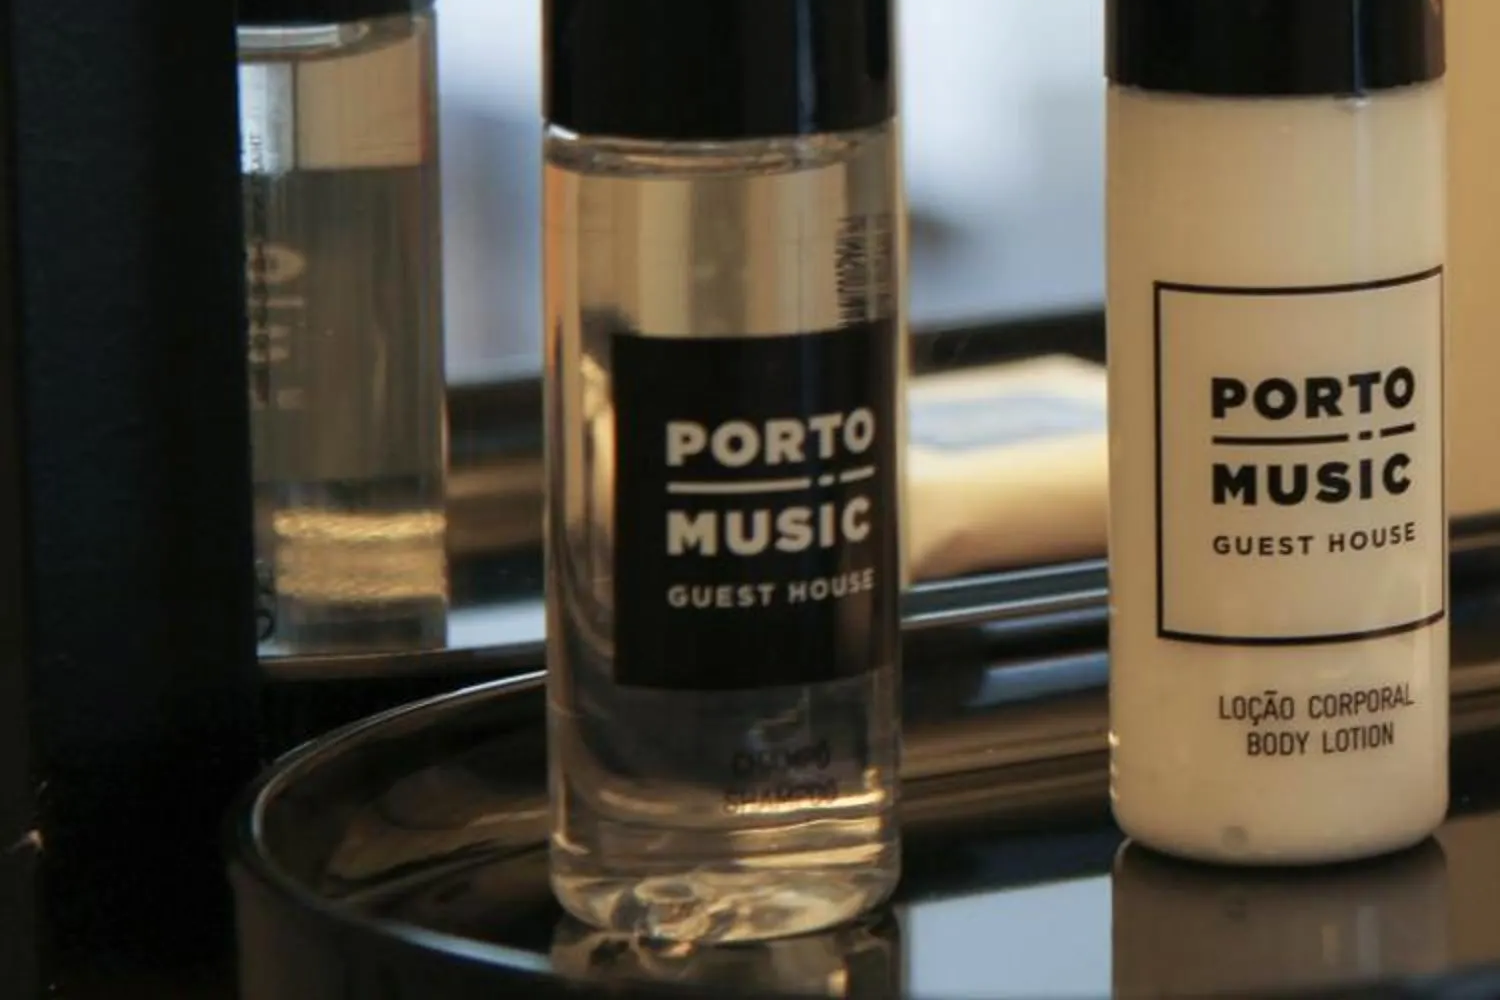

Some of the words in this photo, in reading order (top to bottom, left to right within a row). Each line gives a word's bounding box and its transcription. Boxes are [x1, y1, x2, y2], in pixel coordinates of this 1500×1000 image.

[1211, 366, 1415, 420] PORTO
[666, 408, 876, 467] PORTO
[1211, 452, 1411, 506] MUSIC
[666, 497, 872, 556] MUSIC
[1213, 534, 1313, 556] GUEST
[1328, 522, 1416, 553] HOUSE
[667, 583, 774, 609] GUEST
[788, 568, 875, 603] HOUSE
[1219, 690, 1295, 726] LOÇÃO
[1308, 682, 1415, 720] CORPORAL
[1247, 731, 1309, 757] BODY
[1322, 723, 1394, 754] LOTION
